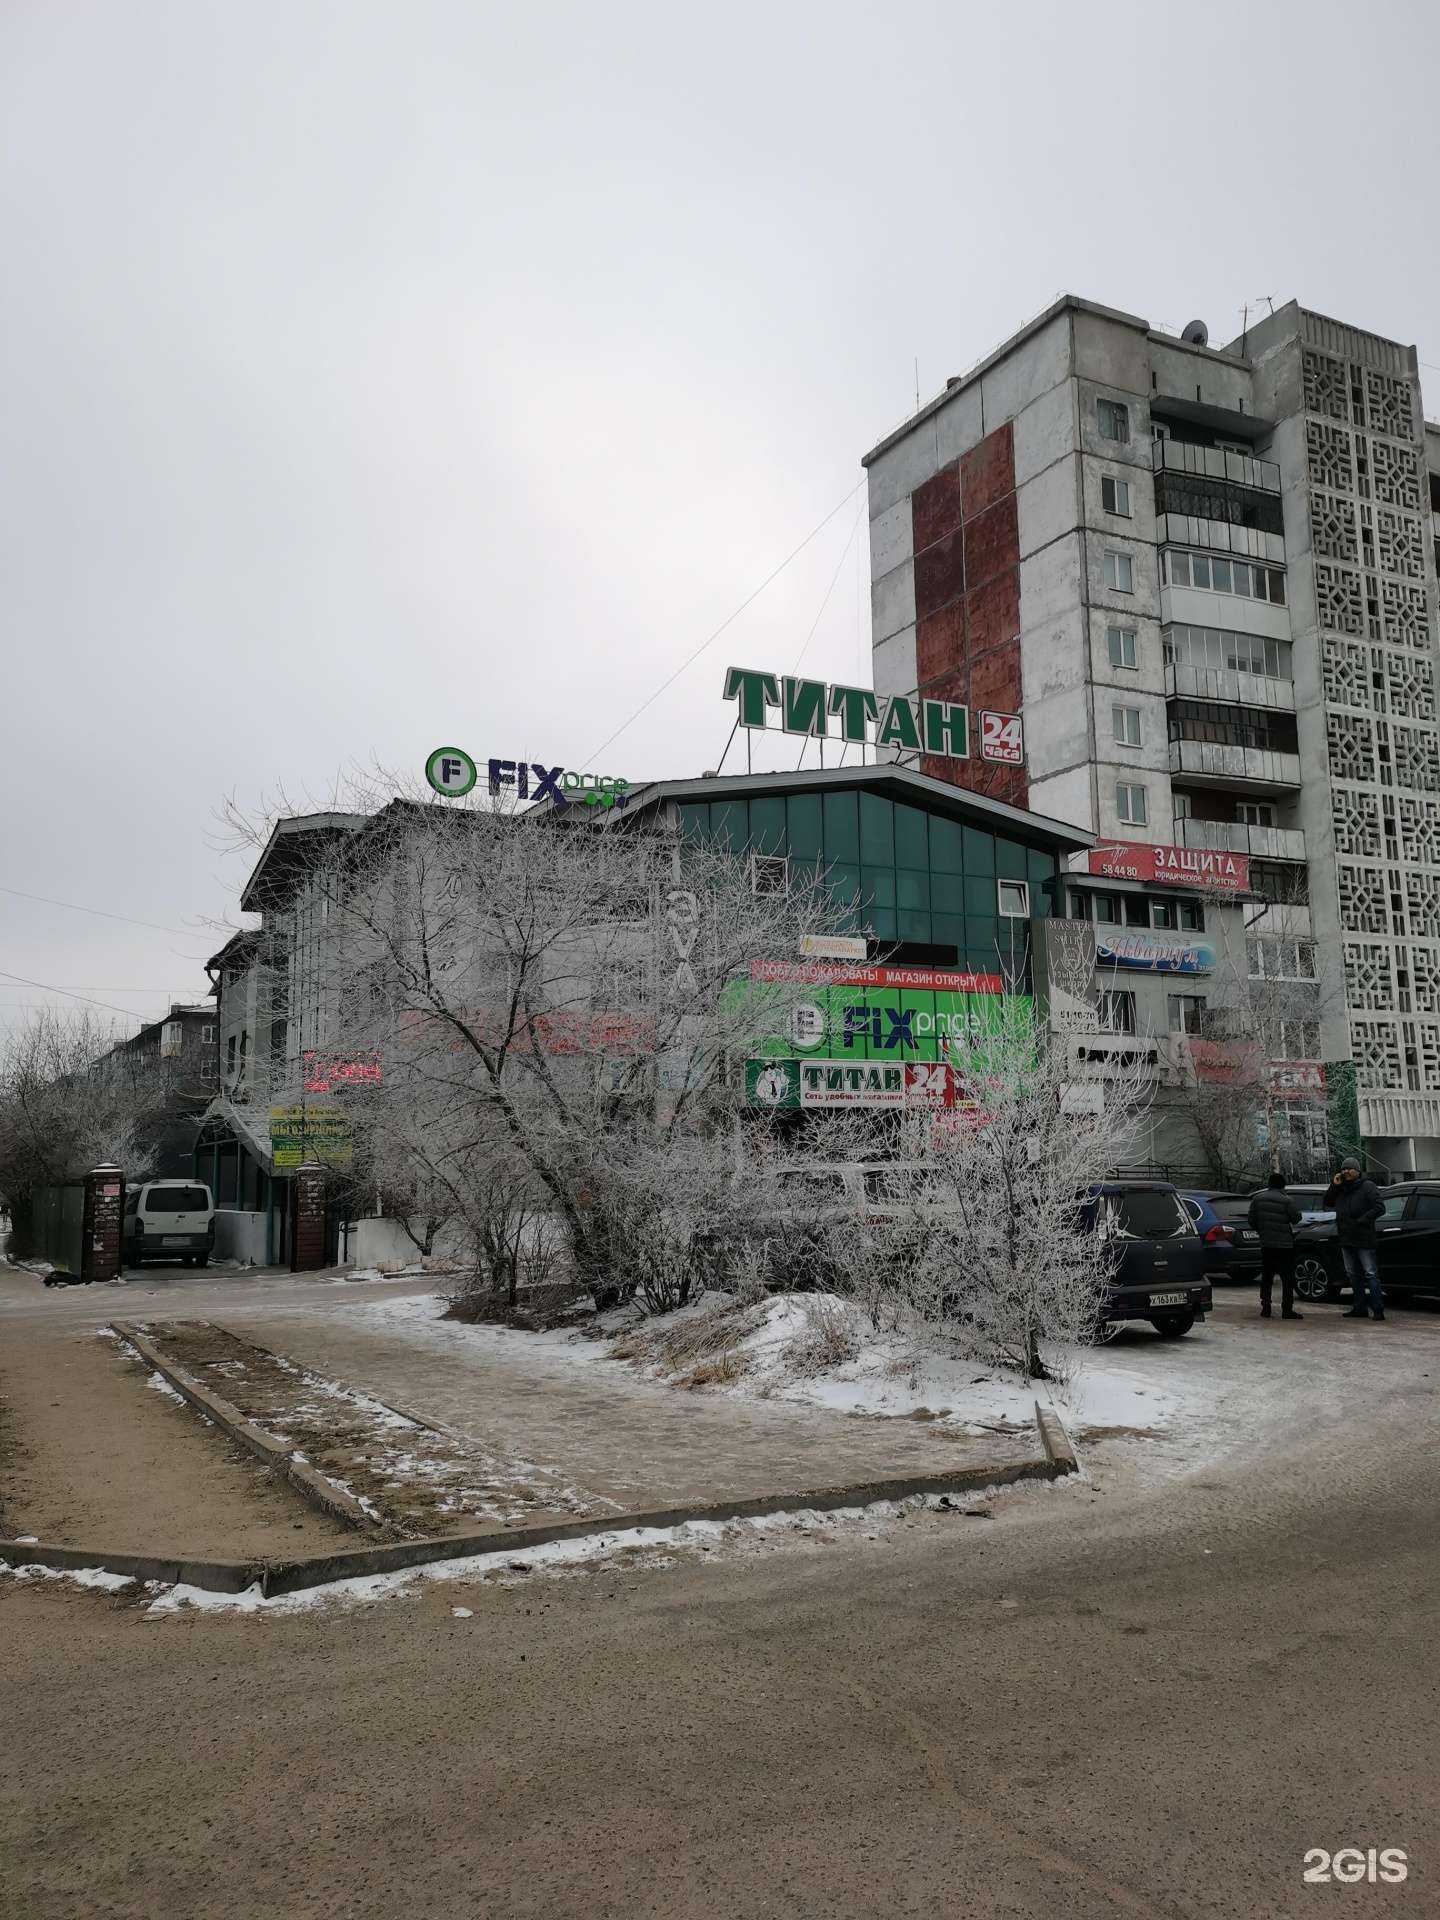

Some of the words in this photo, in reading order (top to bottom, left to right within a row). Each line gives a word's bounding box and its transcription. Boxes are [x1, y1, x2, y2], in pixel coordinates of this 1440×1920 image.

[723, 666, 970, 760] ТИТАН
[983, 714, 1021, 749] 24
[984, 744, 1020, 760] часа
[488, 758, 572, 808] FIX
[563, 770, 629, 792] price
[1102, 863, 1114, 875] 58
[1114, 864, 1126, 876] 44
[1126, 865, 1138, 877] 80
[1153, 847, 1237, 876] ЗАЩИТА
[885, 971, 933, 985] МАГАЗИН
[935, 974, 976, 988] ОТКРЫТ
[842, 1006, 920, 1050] FIX
[916, 1011, 981, 1035] price
[803, 1065, 903, 1092] ТИТАН
[907, 1065, 948, 1094] 24
